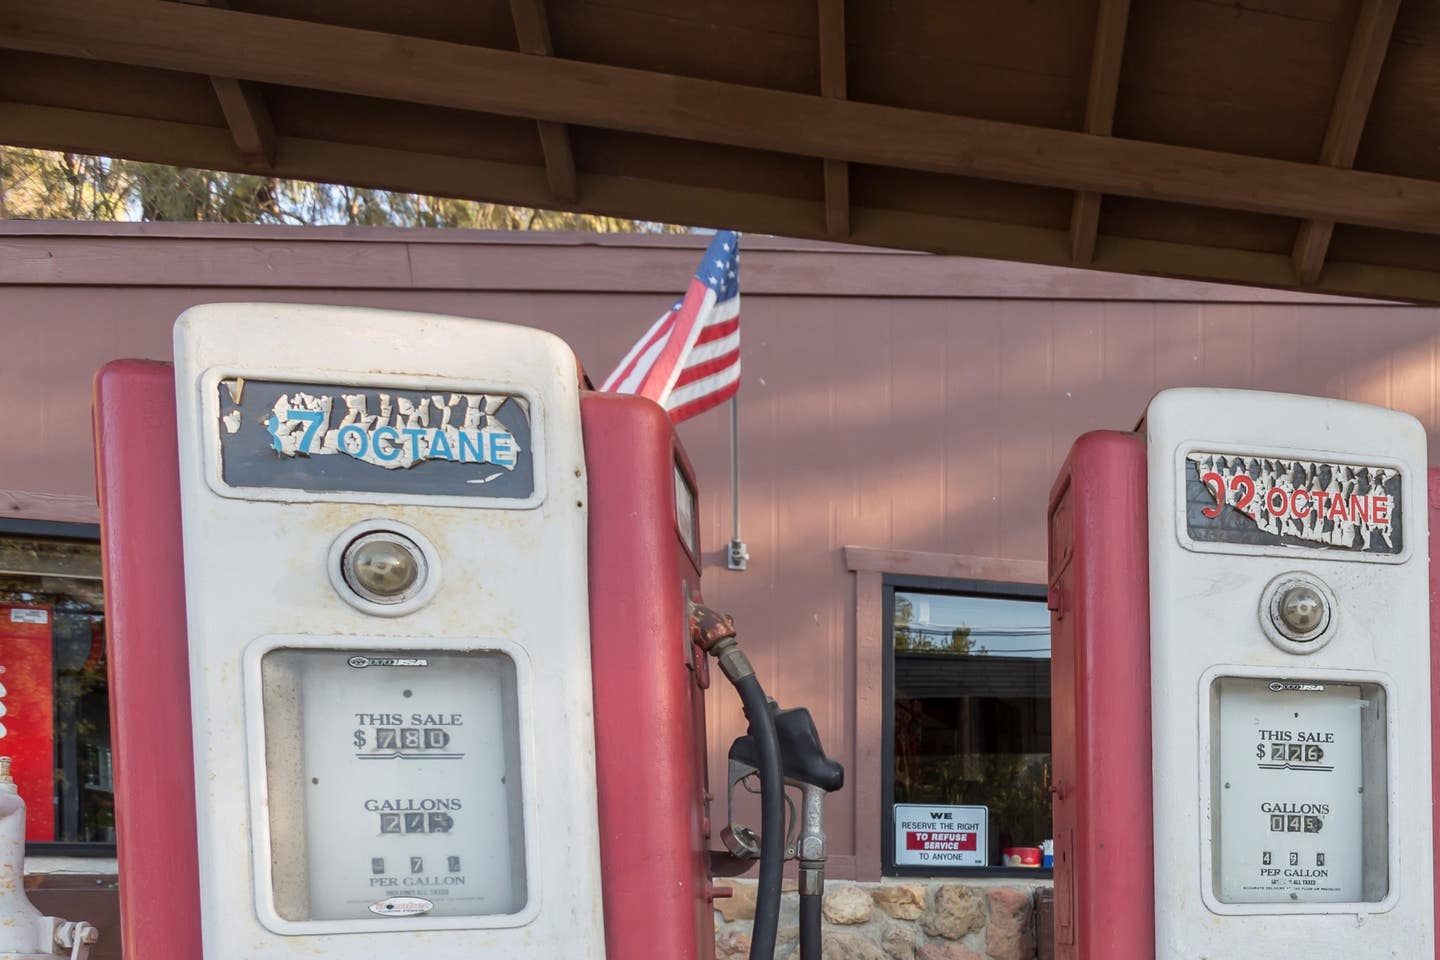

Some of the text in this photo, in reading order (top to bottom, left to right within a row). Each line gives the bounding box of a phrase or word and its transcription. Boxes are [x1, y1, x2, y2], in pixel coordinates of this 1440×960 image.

[337, 424, 514, 466] OCTANE
[1266, 487, 1389, 524] OCTANE
[355, 713, 463, 726] THIS SALE
[353, 729, 366, 749] $
[1258, 729, 1334, 744] THIS SALE
[1256, 743, 1266, 760] $
[364, 798, 462, 812] GALLONS
[1261, 802, 1330, 814] GALLONS
[930, 812, 953, 820] WE
[901, 822, 979, 831] RESERVE THE RIGHT
[916, 833, 967, 841] TO REFUSE
[924, 842, 959, 850] SERVICE
[932, 853, 963, 861] ANYONE
[1260, 868, 1329, 877] PER GALLON
[369, 876, 465, 887] PER GALLON
